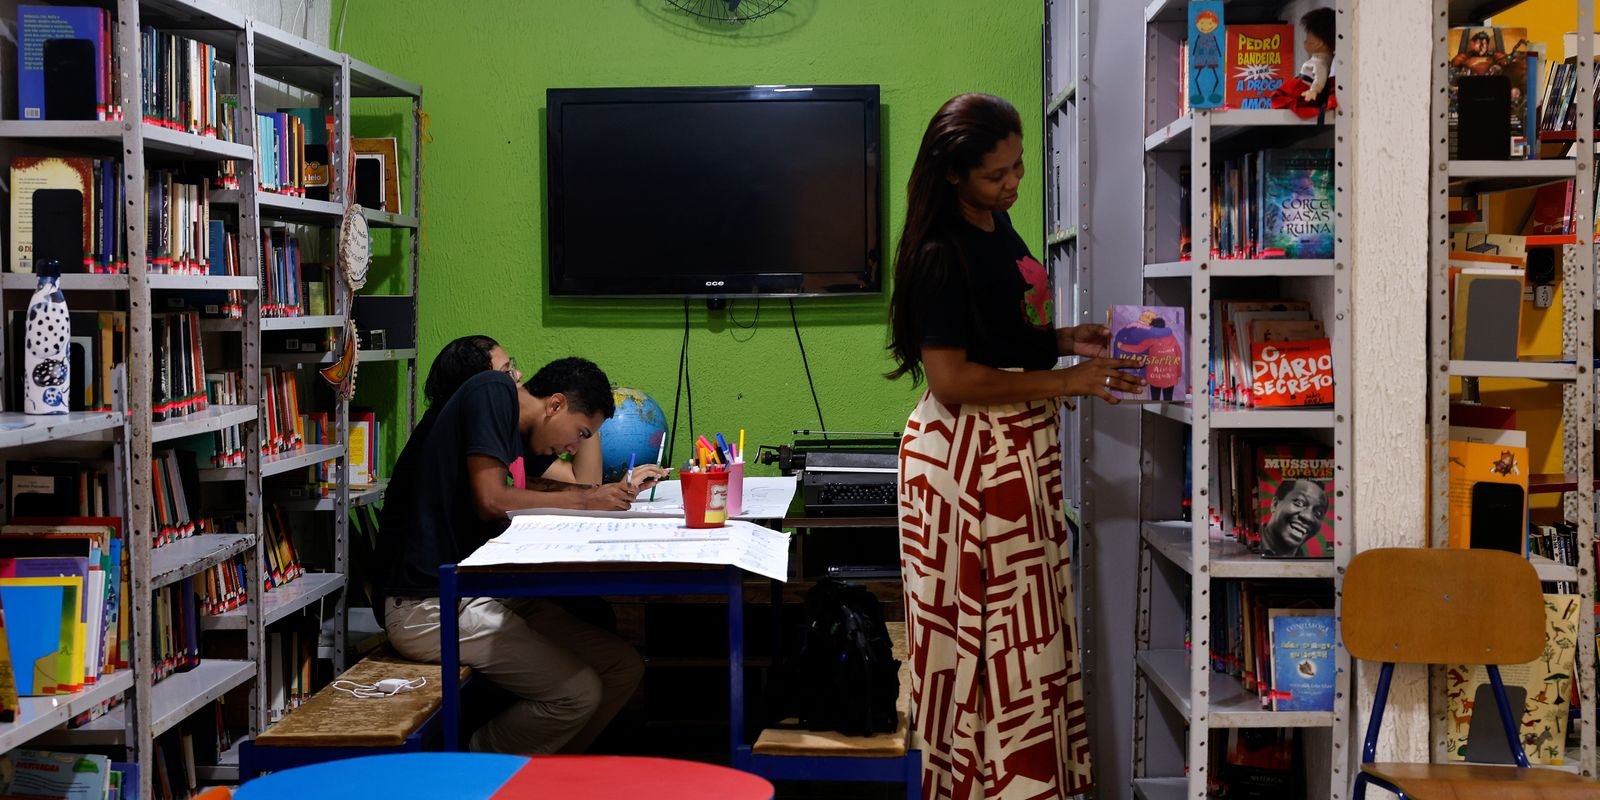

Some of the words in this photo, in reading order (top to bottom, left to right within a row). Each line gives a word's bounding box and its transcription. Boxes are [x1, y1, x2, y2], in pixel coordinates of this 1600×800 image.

[1238, 32, 1281, 50] PEDRO
[1237, 52, 1281, 65] BANDEIRA
[1236, 79, 1244, 91] A
[1282, 198, 1329, 213] CORTE
[1293, 211, 1330, 222] ASAS
[1261, 346, 1280, 362] O
[1253, 354, 1331, 380] DIÁRIO
[1254, 374, 1333, 397] SECRETO
[1264, 458, 1335, 468] MUSSUM
[1281, 463, 1334, 477] forevis
